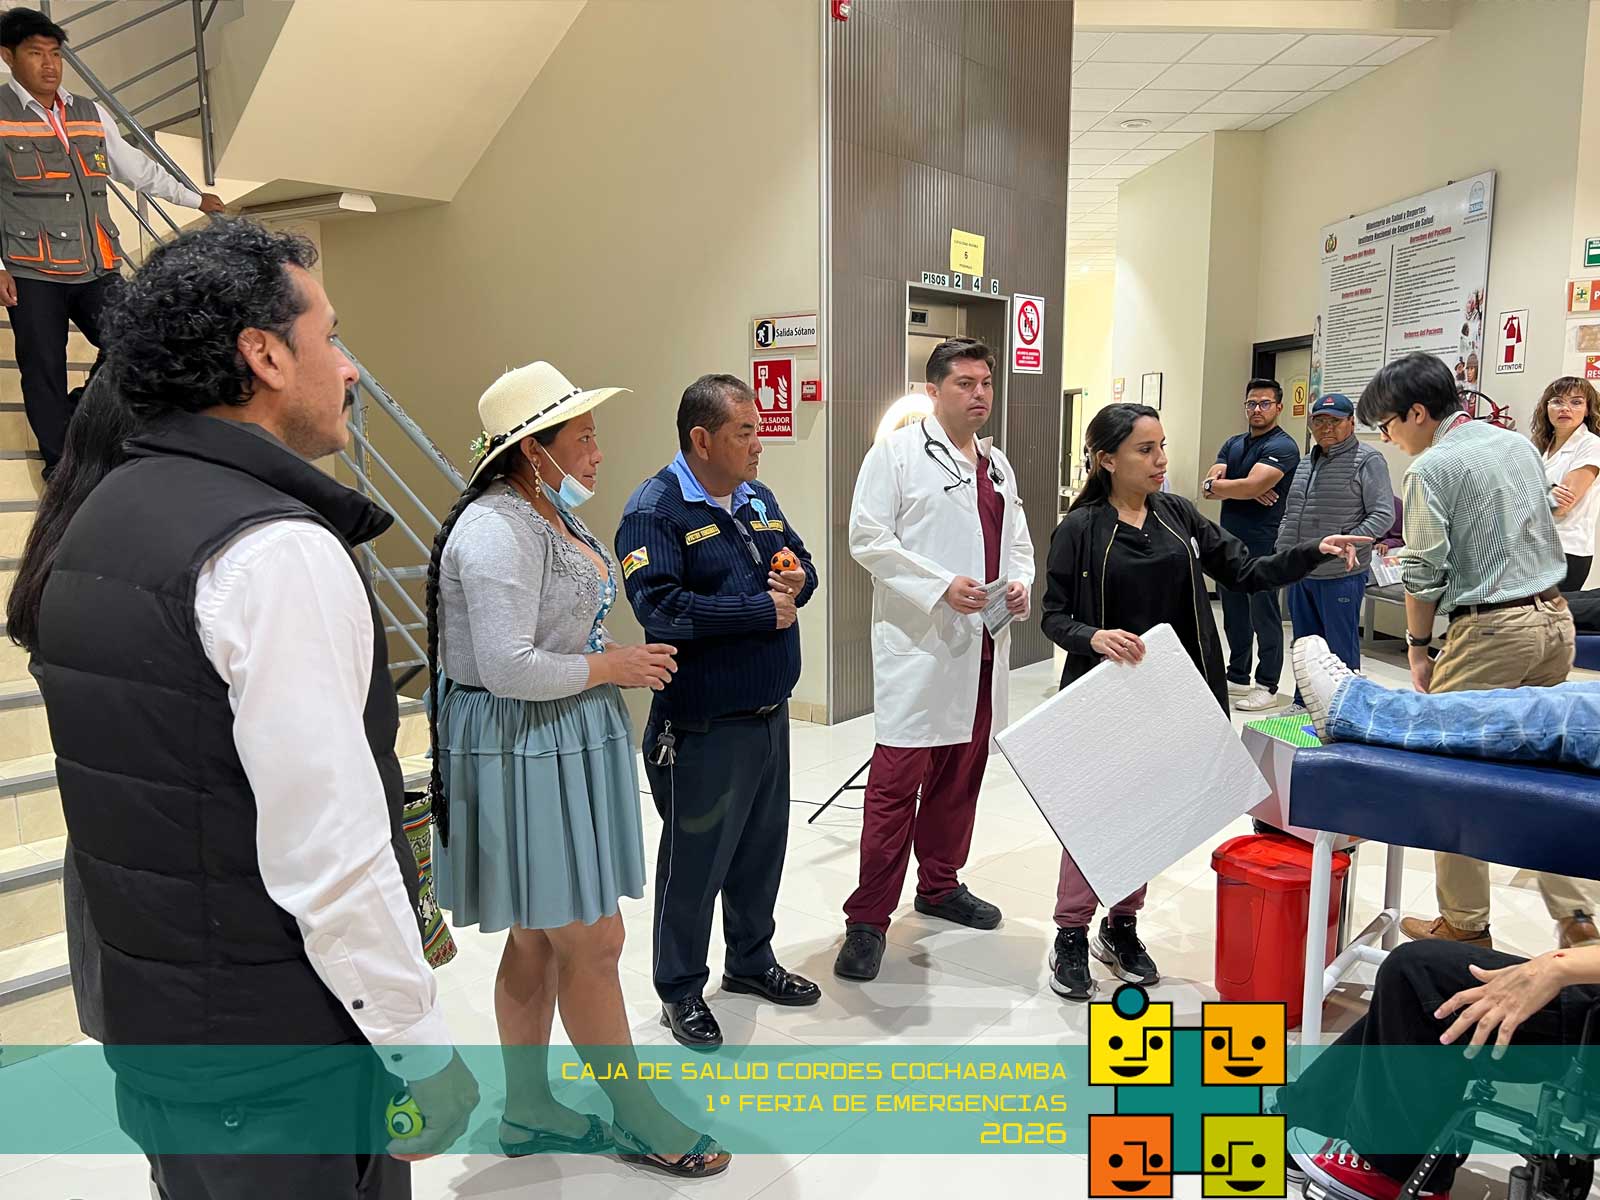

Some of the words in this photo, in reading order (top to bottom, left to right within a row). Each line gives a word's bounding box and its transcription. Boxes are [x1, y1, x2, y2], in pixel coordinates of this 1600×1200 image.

[923, 273, 946, 285] PISOS
[955, 275, 960, 287] 2
[974, 278, 979, 290] 4
[992, 281, 998, 293] 6
[776, 327, 793, 337] Salida
[794, 326, 815, 336] Sótano
